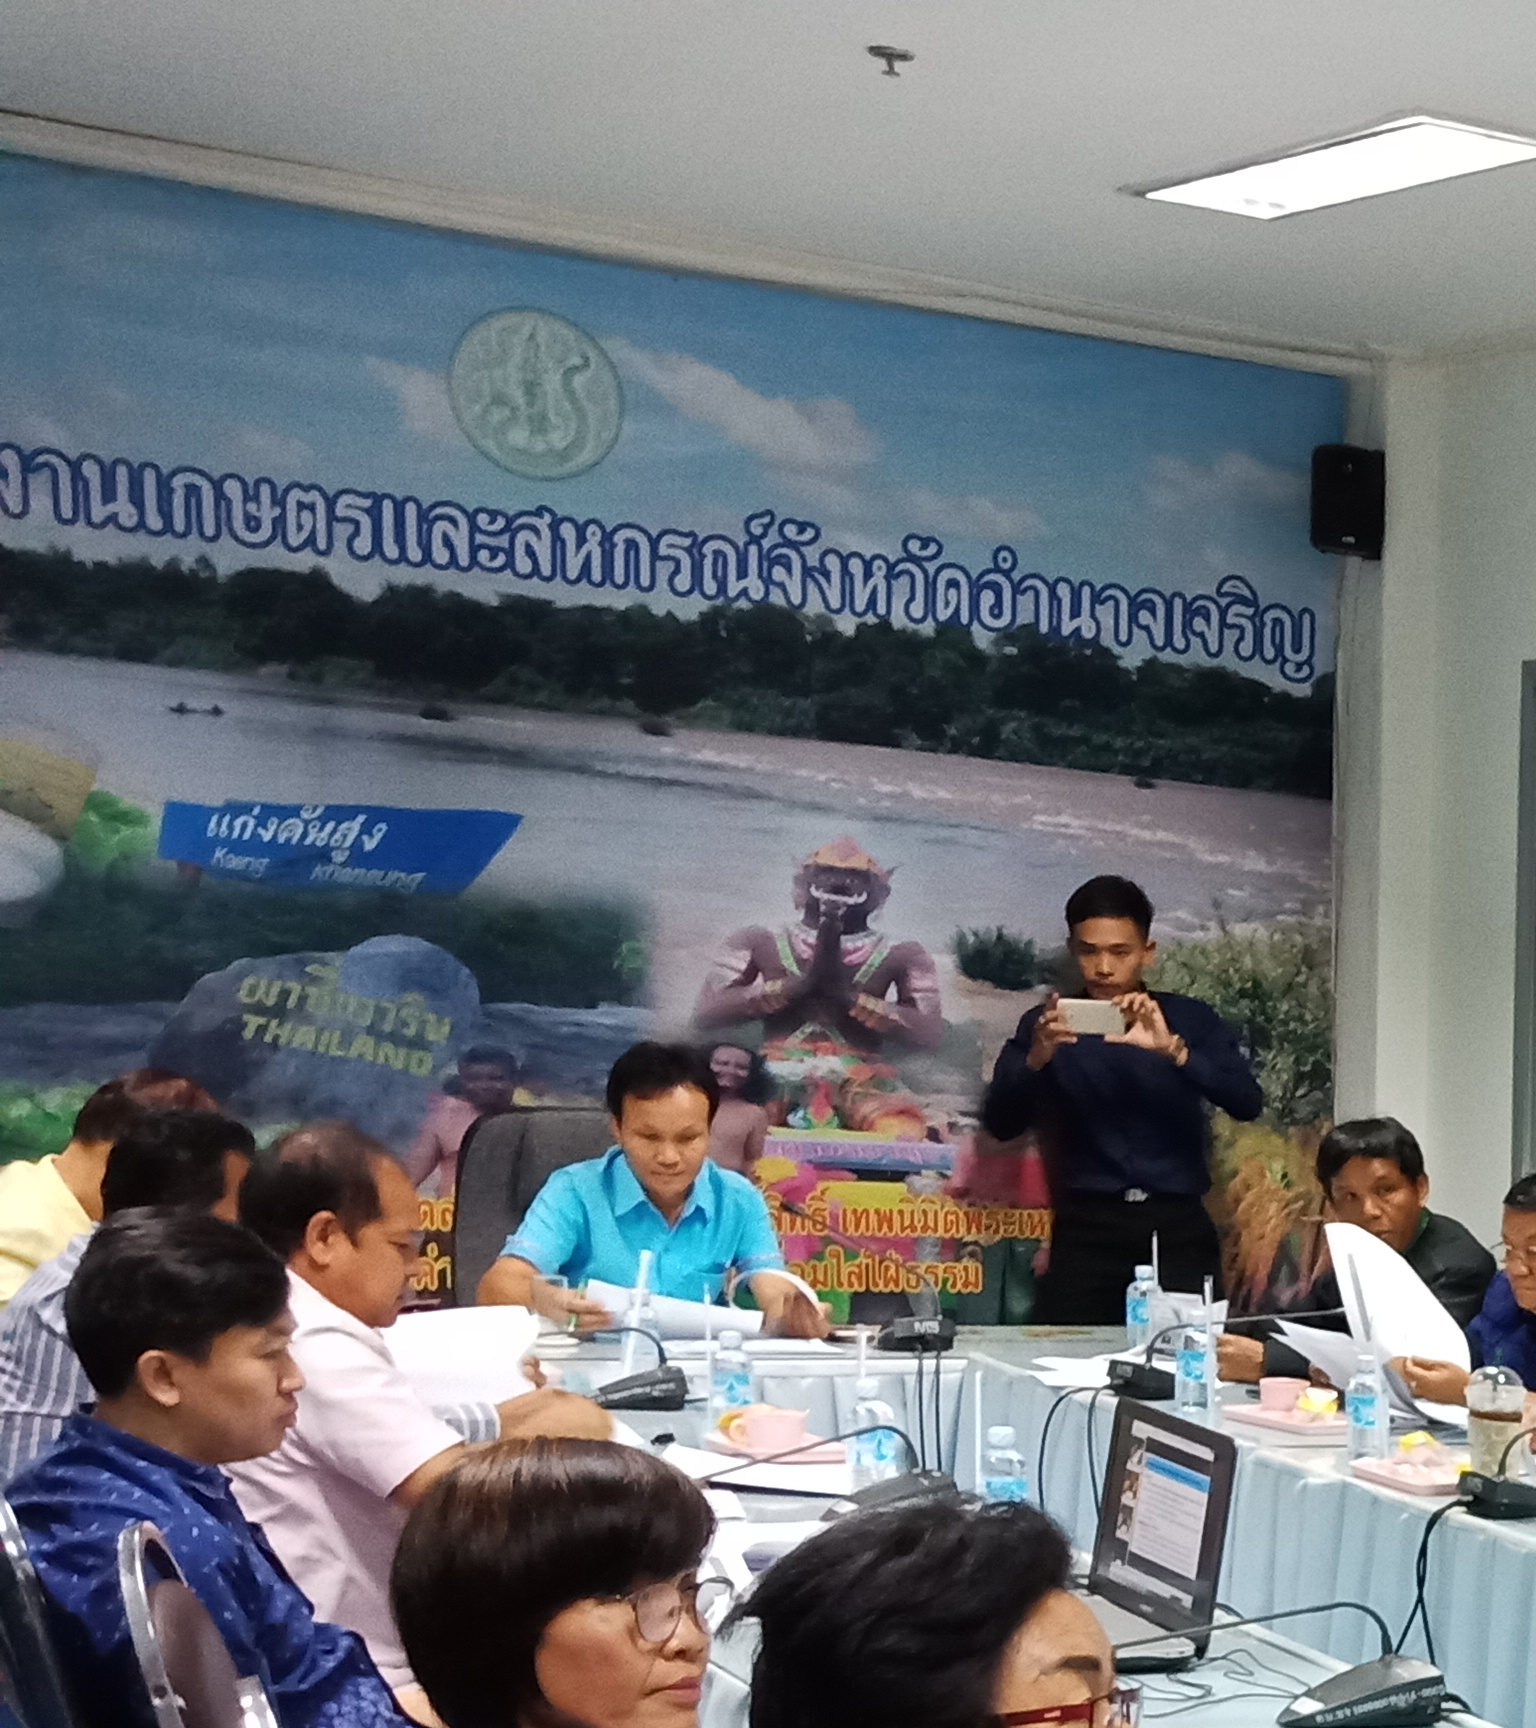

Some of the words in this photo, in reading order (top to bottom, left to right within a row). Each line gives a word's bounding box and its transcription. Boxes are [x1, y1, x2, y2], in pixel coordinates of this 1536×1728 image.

[206, 803, 388, 865] แก่งคันสูง
[242, 1013, 434, 1077] THAILAND
